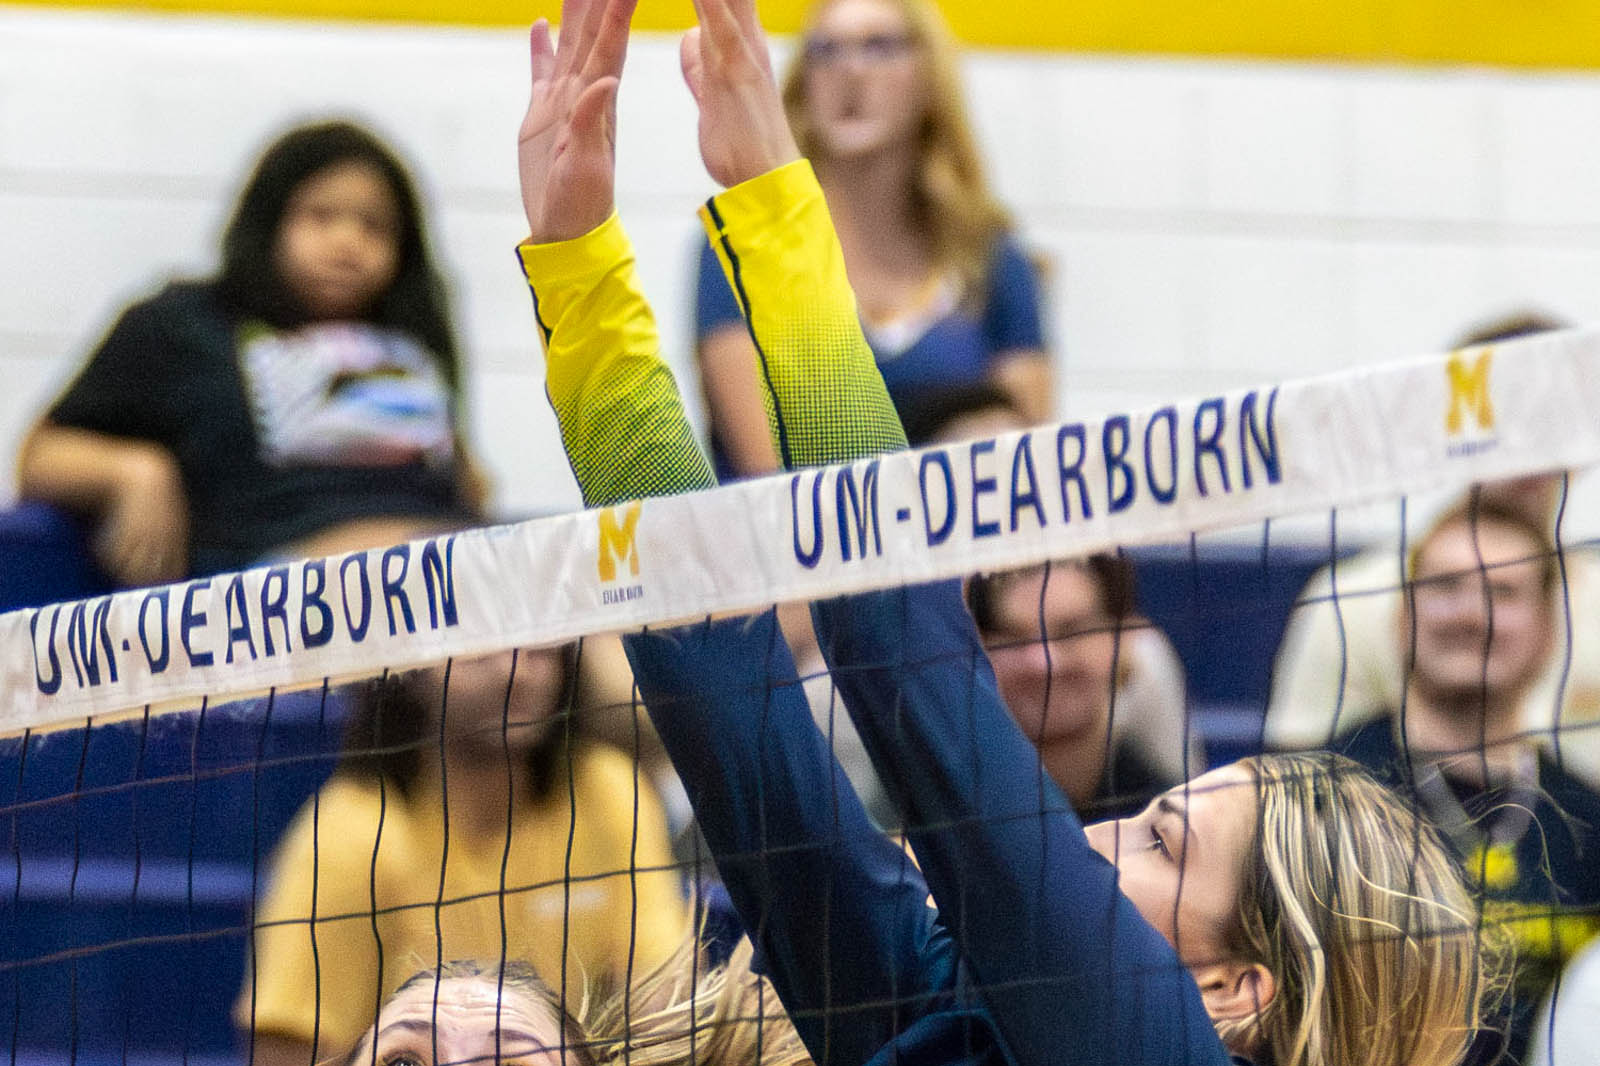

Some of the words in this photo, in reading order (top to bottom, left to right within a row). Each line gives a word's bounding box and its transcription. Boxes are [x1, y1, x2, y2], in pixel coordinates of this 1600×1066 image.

[598, 500, 642, 582] M
[791, 386, 1282, 569] UM-DEARBORN
[30, 537, 458, 695] UM-DEARBORN
